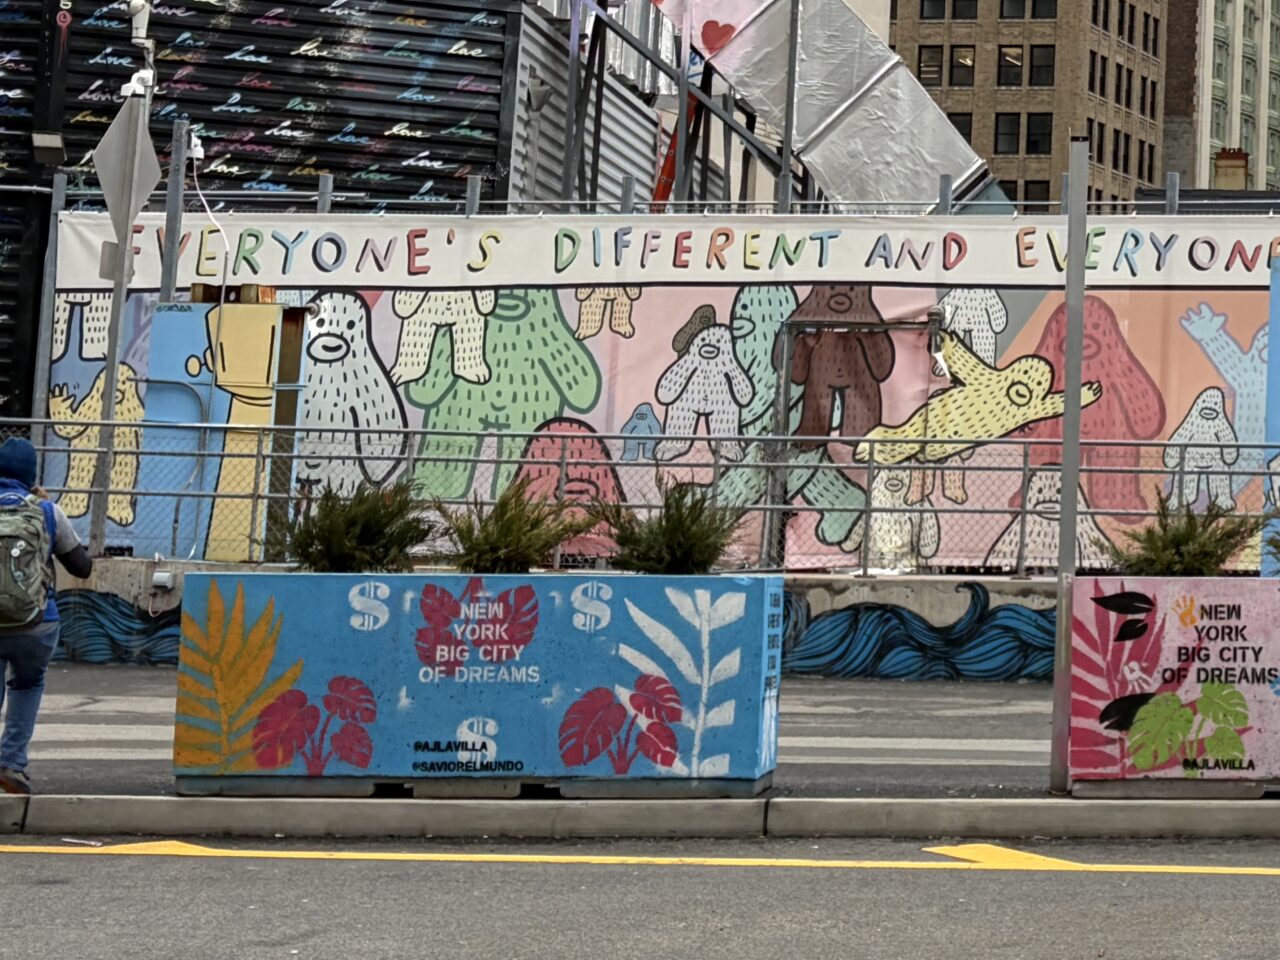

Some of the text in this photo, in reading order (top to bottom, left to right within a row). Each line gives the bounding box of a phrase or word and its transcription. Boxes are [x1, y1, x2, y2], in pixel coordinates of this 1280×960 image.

[384, 122, 431, 138] love
[401, 151, 459, 169] love
[554, 226, 842, 273] DIFFERENT
[865, 232, 969, 271] AND
[460, 602, 504, 620] NEW
[1200, 604, 1241, 620] NEW
[454, 623, 509, 641] YORK
[1194, 625, 1247, 641] YORK
[435, 644, 525, 662] BIG CITY
[1177, 646, 1263, 663] BIG CITY
[418, 666, 540, 683] OF DREAMS
[1161, 668, 1279, 684] OF DREAMS
[412, 760, 524, 772] @SAVIORELMUNDO
